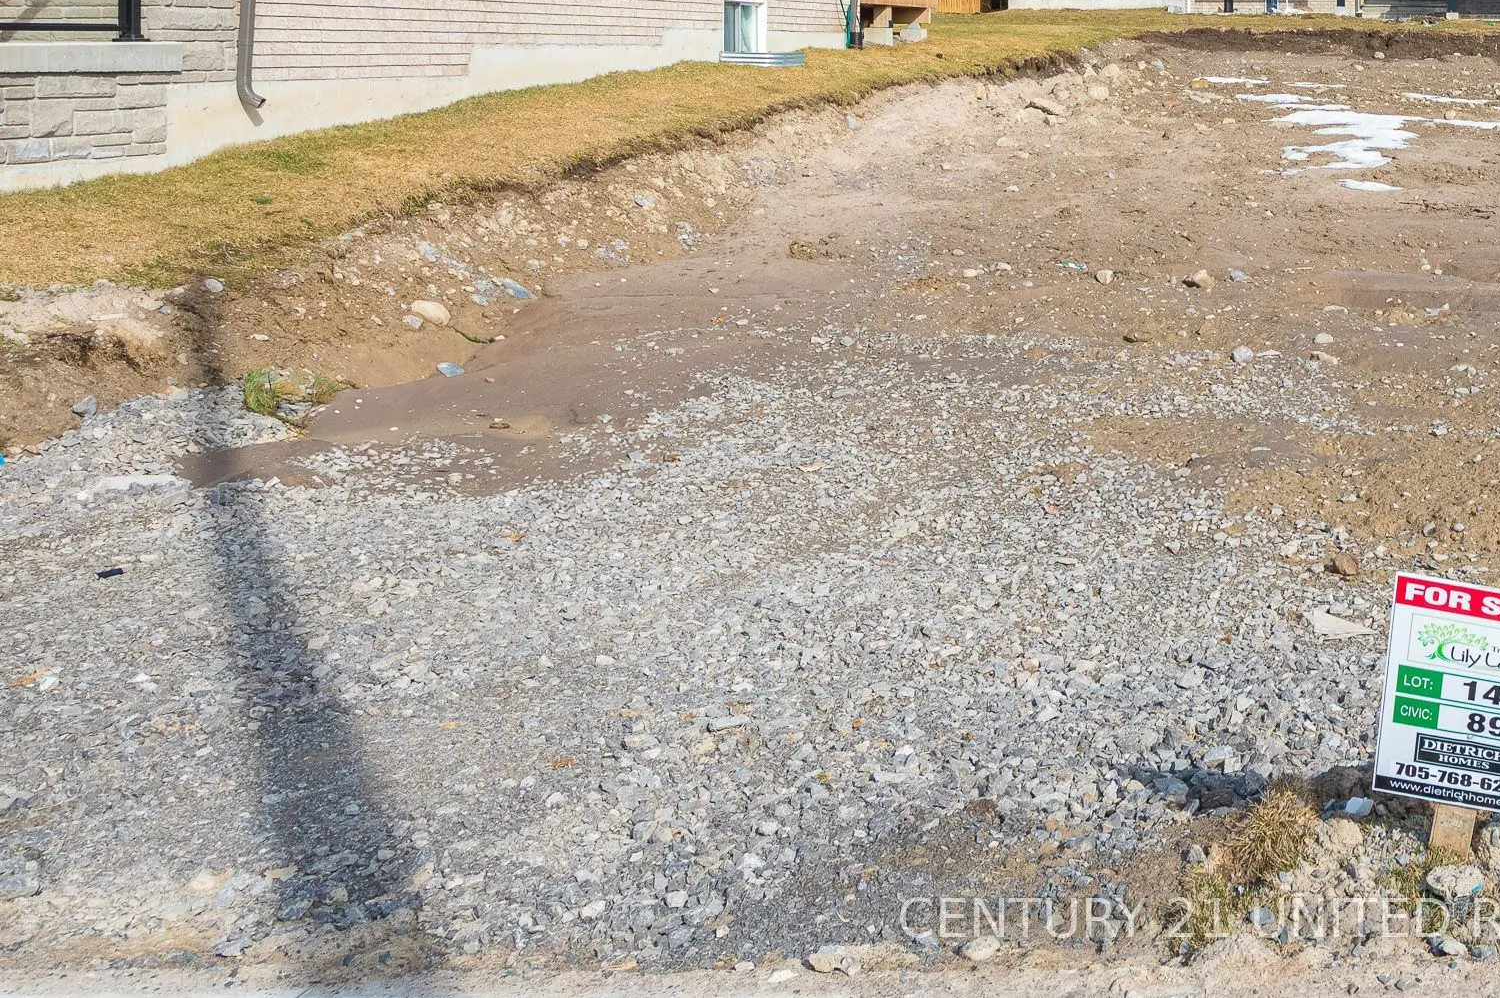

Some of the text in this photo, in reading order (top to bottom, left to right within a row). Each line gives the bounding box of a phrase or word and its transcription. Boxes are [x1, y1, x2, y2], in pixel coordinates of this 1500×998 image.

[1404, 582, 1472, 612] FOR
[1450, 645, 1482, 669] Lily
[1403, 674, 1434, 690] LOT:
[1400, 705, 1433, 721] CIVIC:
[1438, 753, 1490, 771] HOMES
